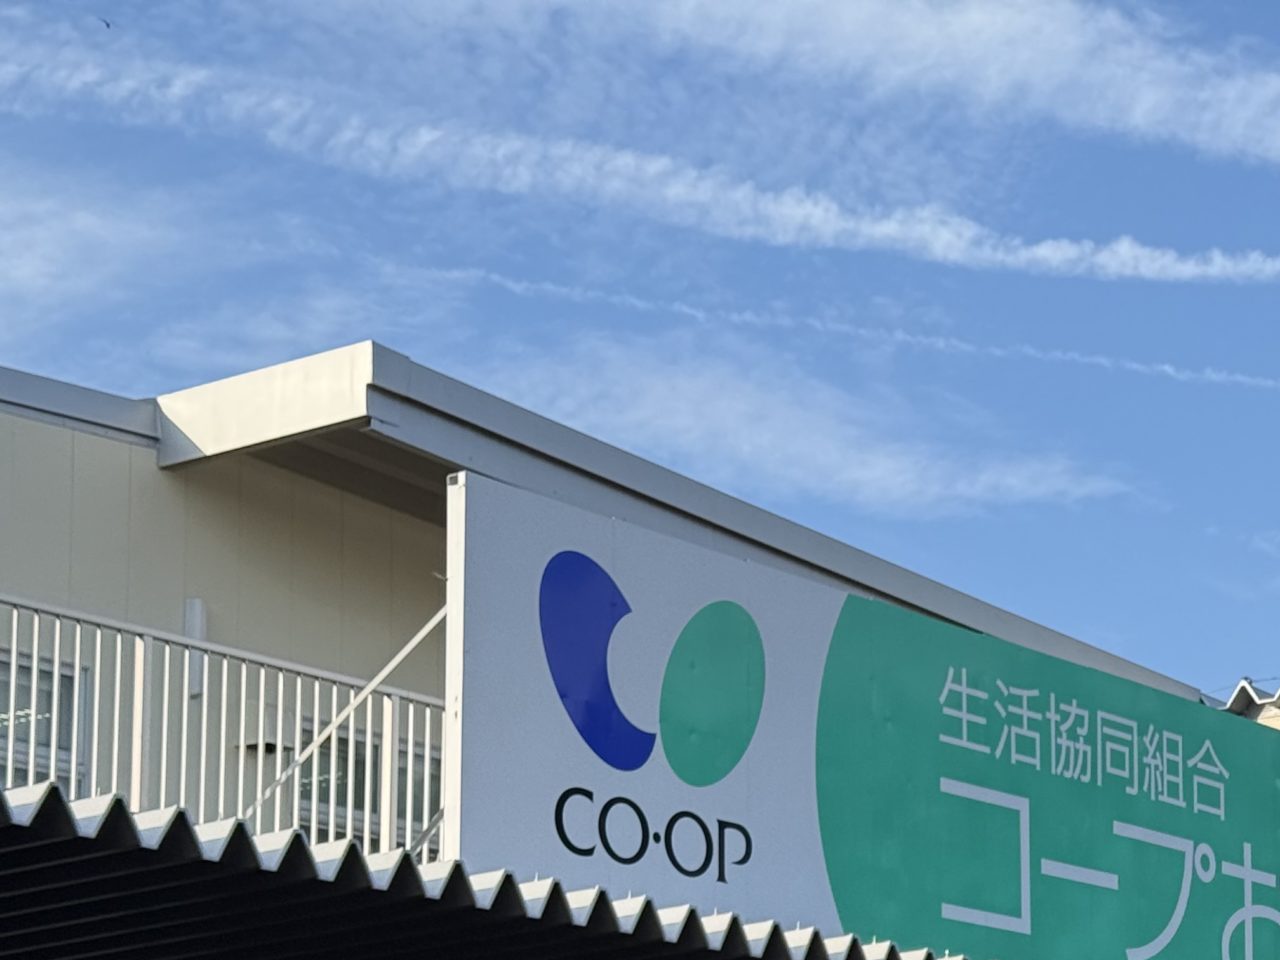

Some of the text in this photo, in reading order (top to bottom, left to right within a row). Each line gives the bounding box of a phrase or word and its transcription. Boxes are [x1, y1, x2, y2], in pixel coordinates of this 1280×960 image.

[938, 666, 1230, 821] 生活協同組合
